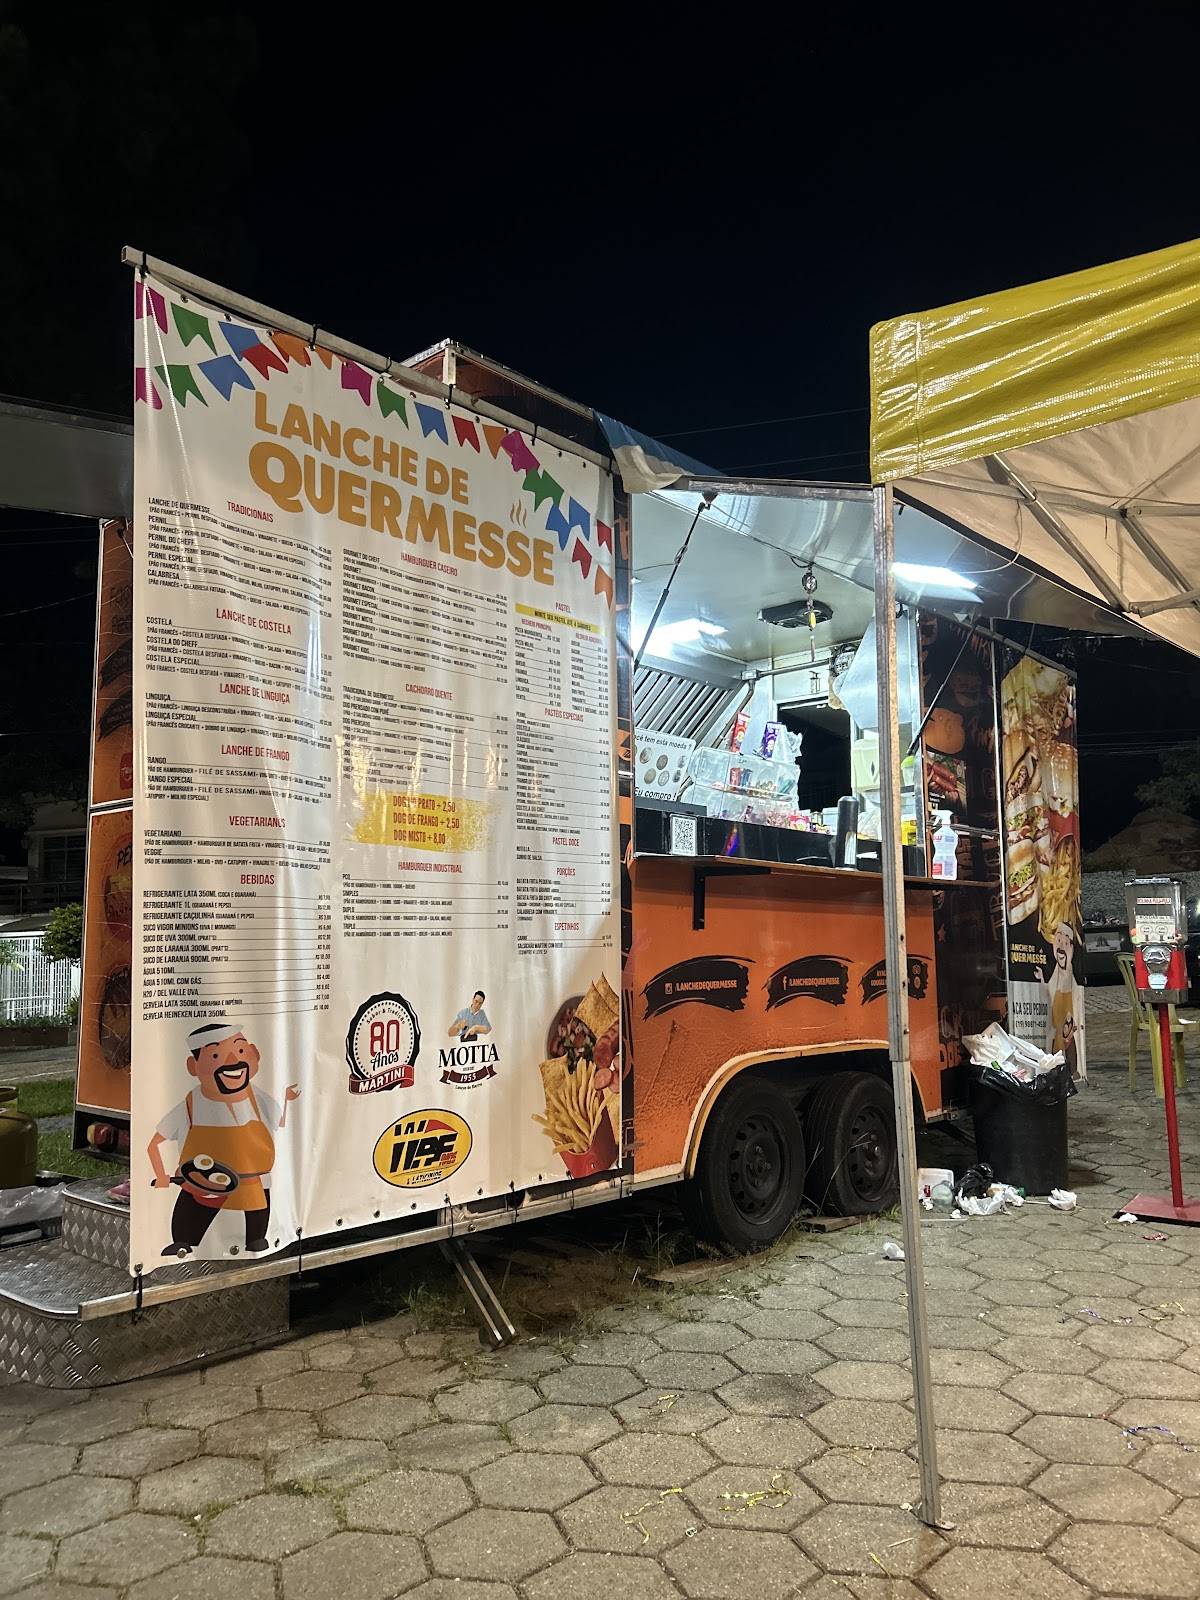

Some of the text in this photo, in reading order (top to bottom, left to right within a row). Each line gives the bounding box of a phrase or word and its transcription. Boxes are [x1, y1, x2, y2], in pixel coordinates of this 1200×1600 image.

[255, 390, 468, 504] LANCHE DE
[149, 497, 210, 513] LANCHE DE QUERMESSE
[227, 500, 274, 523] TRADICIONAIS
[249, 441, 555, 586] QUERMESSE
[149, 515, 167, 524] PERNIL
[148, 533, 167, 542] PERNIL
[148, 551, 193, 563] PERNIL ESPECIAL
[343, 564, 361, 574] GOURMET
[401, 552, 458, 576] HAMBURGUER CASEIRO
[148, 569, 179, 579] CALABRESA
[343, 580, 374, 593] GOURMET BACON
[556, 602, 570, 612] PASTEL
[147, 616, 172, 625] COSTELA
[216, 608, 292, 634] LANCHE DE COSTELA
[147, 636, 171, 644] COSTELA
[173, 638, 180, 646] DO
[146, 654, 200, 665] COSTELA ESPECIAL
[220, 682, 290, 704] LANCHE DE LINGUIÇA
[406, 683, 452, 700] CACHORRO QUENTE
[146, 692, 171, 702] LINGUIÇA
[351, 703, 370, 712] PRENSADO
[146, 711, 197, 721] LINGUIÇA ESPECIAL
[545, 708, 584, 722] PASTÉIS ESPECIAIS
[669, 741, 686, 749] moeda
[222, 744, 290, 761] LANCHE DE FRANGO
[167, 776, 193, 784] ESPECIAL
[635, 787, 643, 795] Eu
[645, 790, 671, 800] compro
[393, 796, 406, 808] DOG
[418, 798, 435, 810] PRATO
[443, 801, 456, 812] 2,50
[229, 815, 286, 828] VEGETARIANOS
[393, 812, 406, 824] DOG
[408, 813, 416, 825] DE
[417, 814, 438, 827] FRANGO
[446, 817, 460, 829] 2,50
[144, 829, 181, 837] VEGETARIANO
[394, 829, 406, 841] DOG
[408, 830, 426, 842] MISTO
[434, 832, 445, 844] 8,00
[553, 837, 568, 846] PASTEL
[116, 842, 132, 870] PE
[144, 848, 162, 856] VEGGIE
[398, 862, 462, 873] HAMBURGUER INDUSTRIAL
[557, 867, 575, 877] PORÇÕES
[240, 874, 275, 885] BEBIDAS
[143, 890, 182, 898] REFRIGERANTE
[184, 912, 214, 920] CAÇULINHA
[554, 923, 579, 931] ESPETINHOS
[1010, 943, 1028, 952] ANCHE
[144, 966, 155, 975] ÁGUA
[144, 977, 155, 986] ÁGUA
[190, 976, 202, 984] GÁS
[187, 988, 198, 996] UVA
[143, 1000, 164, 1009] CERVEJA
[1023, 1002, 1032, 1016] SEU
[1033, 1003, 1047, 1016] PEDIDO
[143, 1011, 164, 1020] CERVEJA
[193, 1010, 207, 1018] LATA
[370, 1020, 400, 1057] 80
[371, 1050, 399, 1071] Anos
[438, 1043, 500, 1068] MOTTA
[359, 1067, 405, 1092] MARTINI
[460, 1073, 476, 1082] 1955
